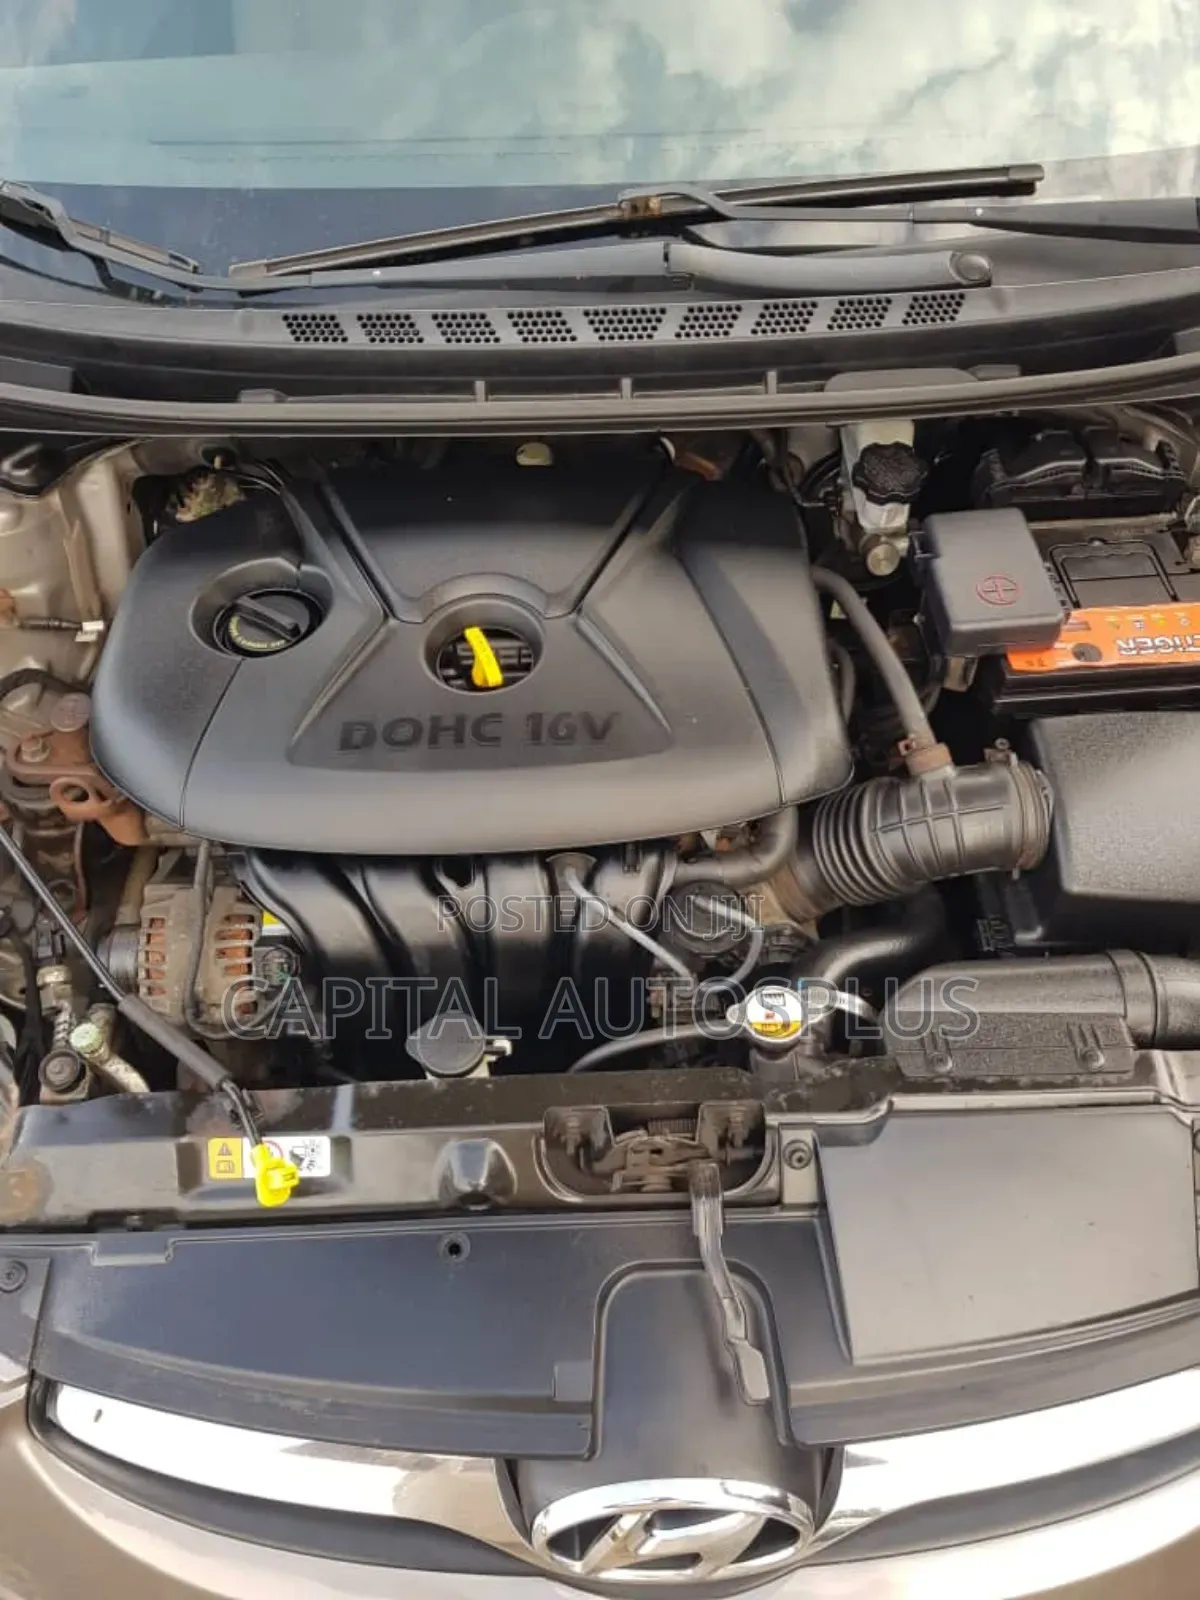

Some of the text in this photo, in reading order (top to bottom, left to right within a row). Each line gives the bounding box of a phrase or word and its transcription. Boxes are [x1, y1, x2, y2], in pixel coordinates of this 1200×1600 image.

[1116, 634, 1200, 656] TIGER
[338, 711, 619, 752] DOHC 16V
